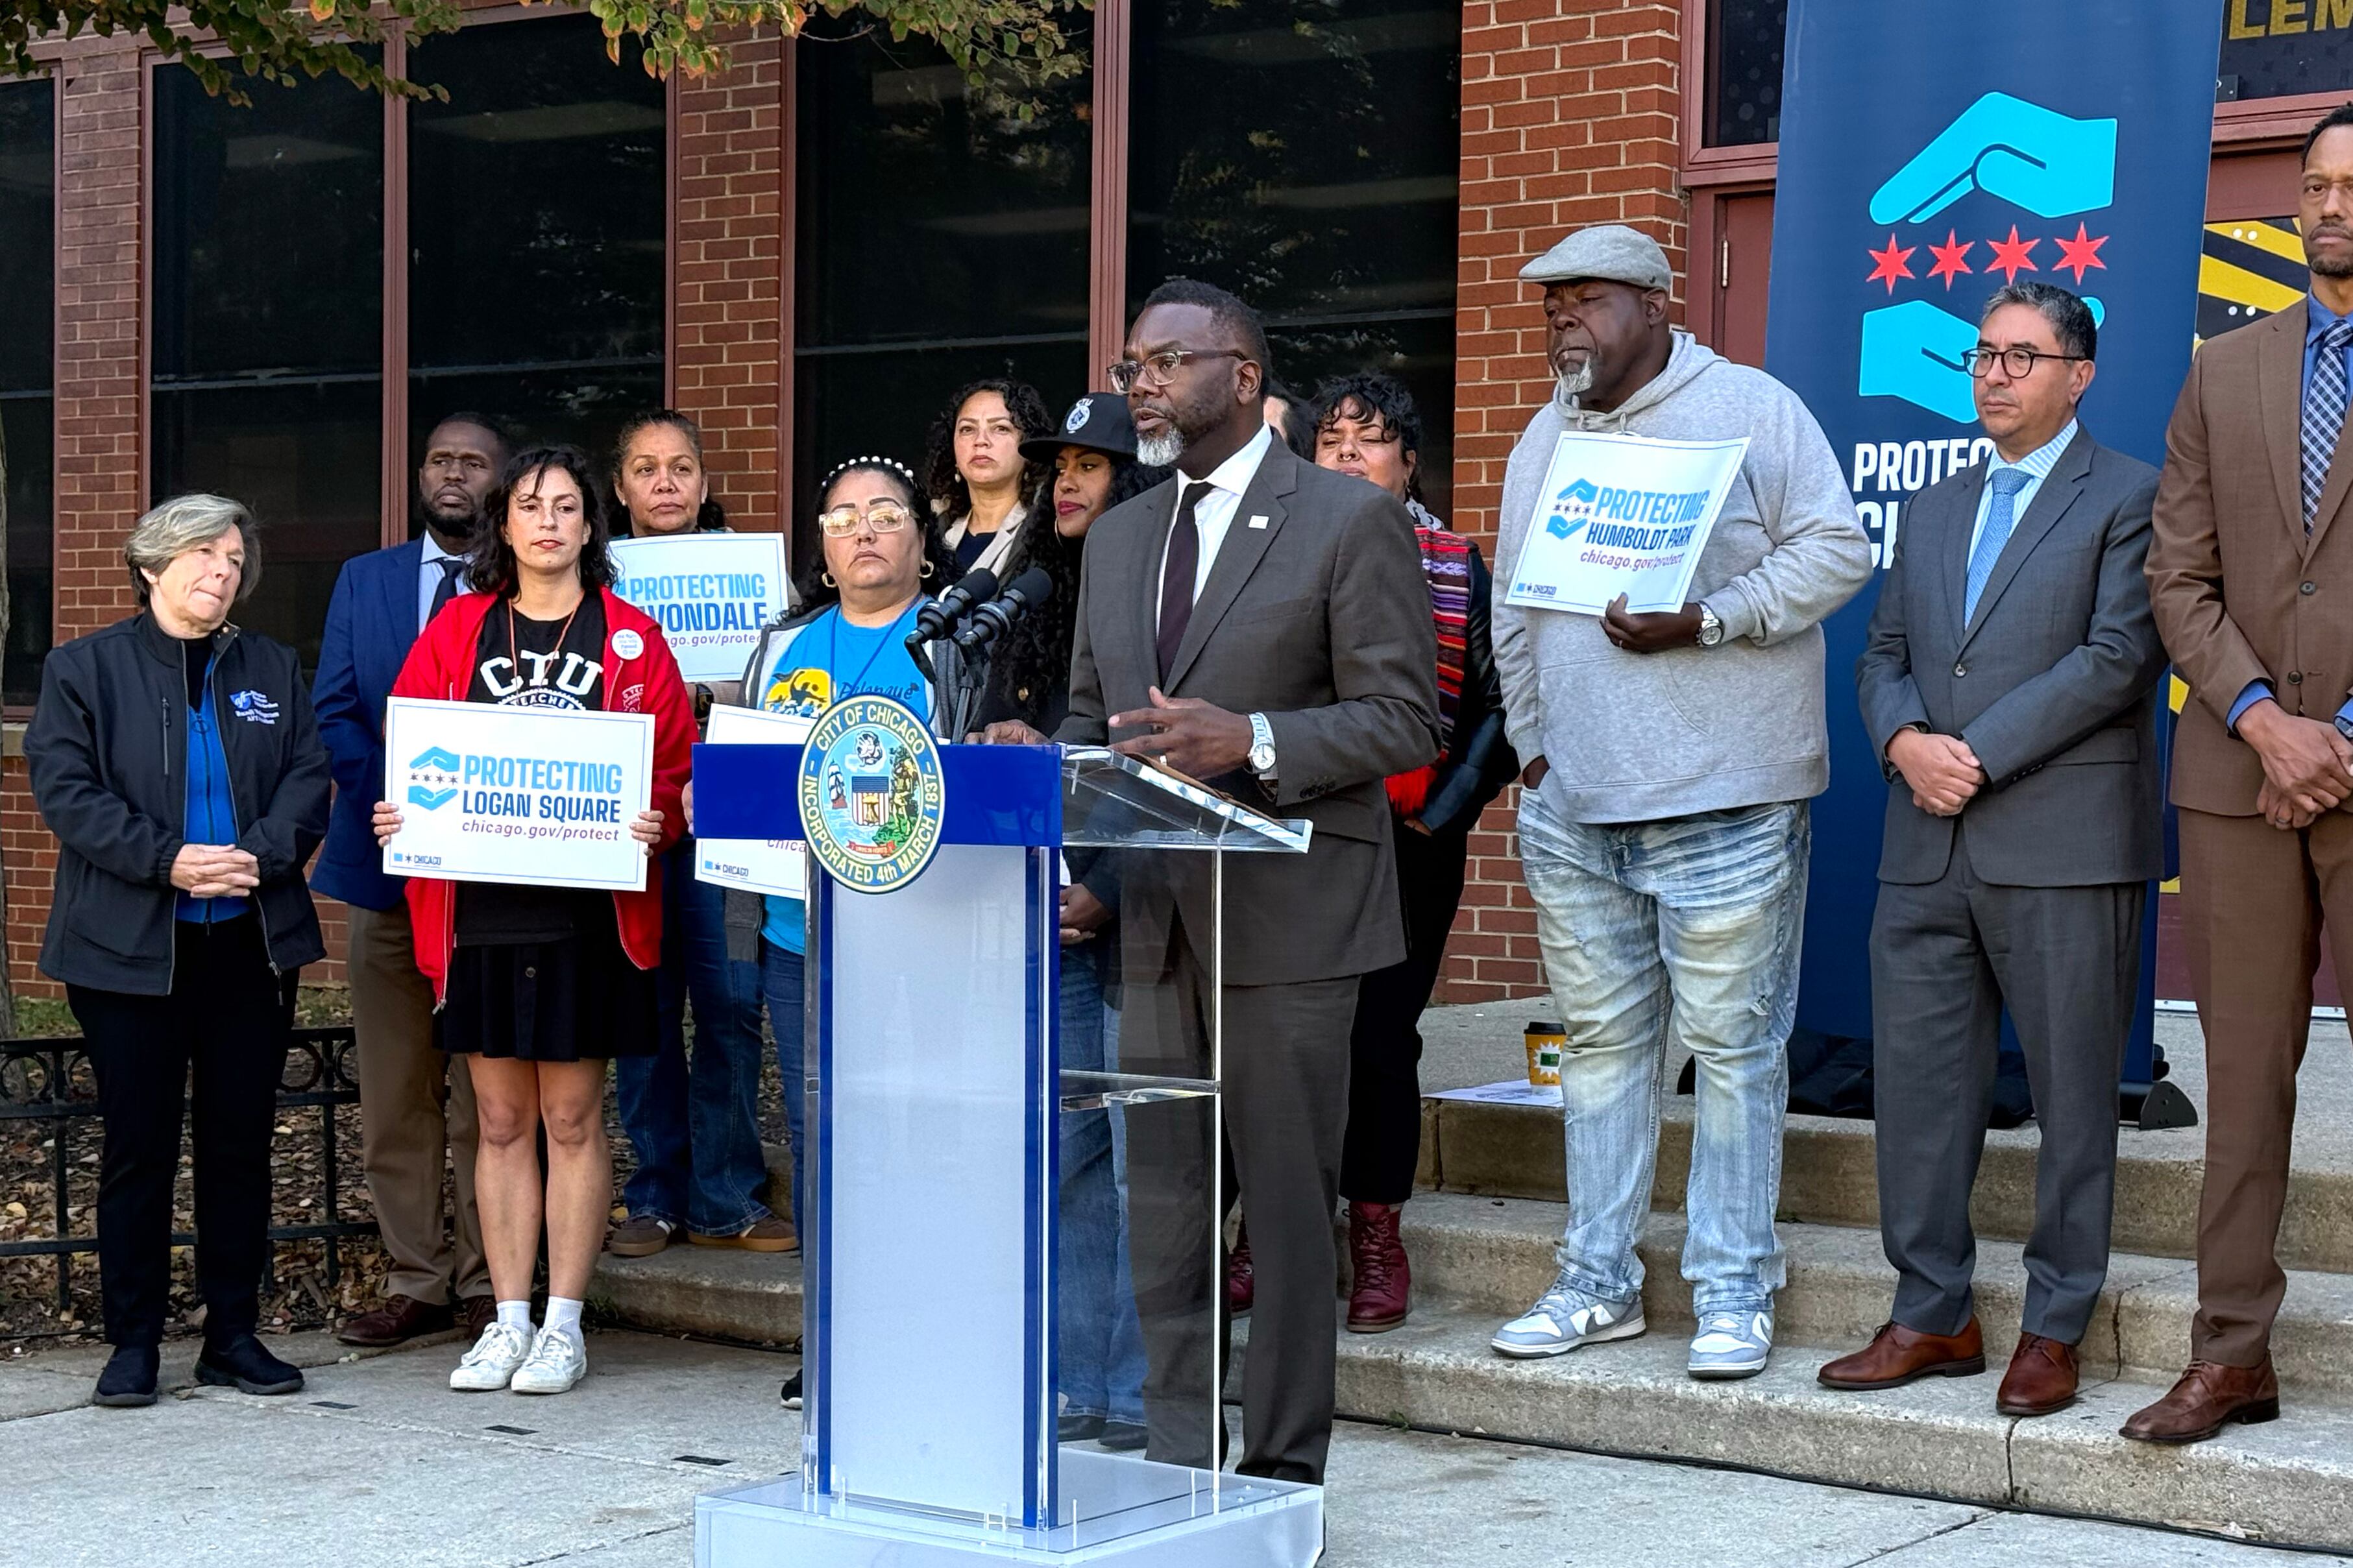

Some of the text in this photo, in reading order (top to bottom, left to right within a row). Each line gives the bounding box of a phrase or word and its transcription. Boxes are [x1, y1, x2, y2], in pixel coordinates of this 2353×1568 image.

[1594, 487, 1710, 524] PROTECTING
[1585, 522, 1697, 550] HUMBOLDT PARK
[1580, 549, 1685, 572] chicago.gov/protect
[629, 573, 766, 602] PROTECTING
[638, 602, 767, 632] VONDALE
[480, 649, 604, 697] CTU
[816, 704, 925, 755] CITY OF CHICAGO
[465, 755, 622, 794] PROTECTING
[462, 790, 621, 824] LOGAN SQUARE
[461, 820, 619, 842] chicago.gov/protect
[804, 773, 938, 883] INCORPORATED 4th MARCH 1837
[722, 863, 749, 877] CHICAGO
